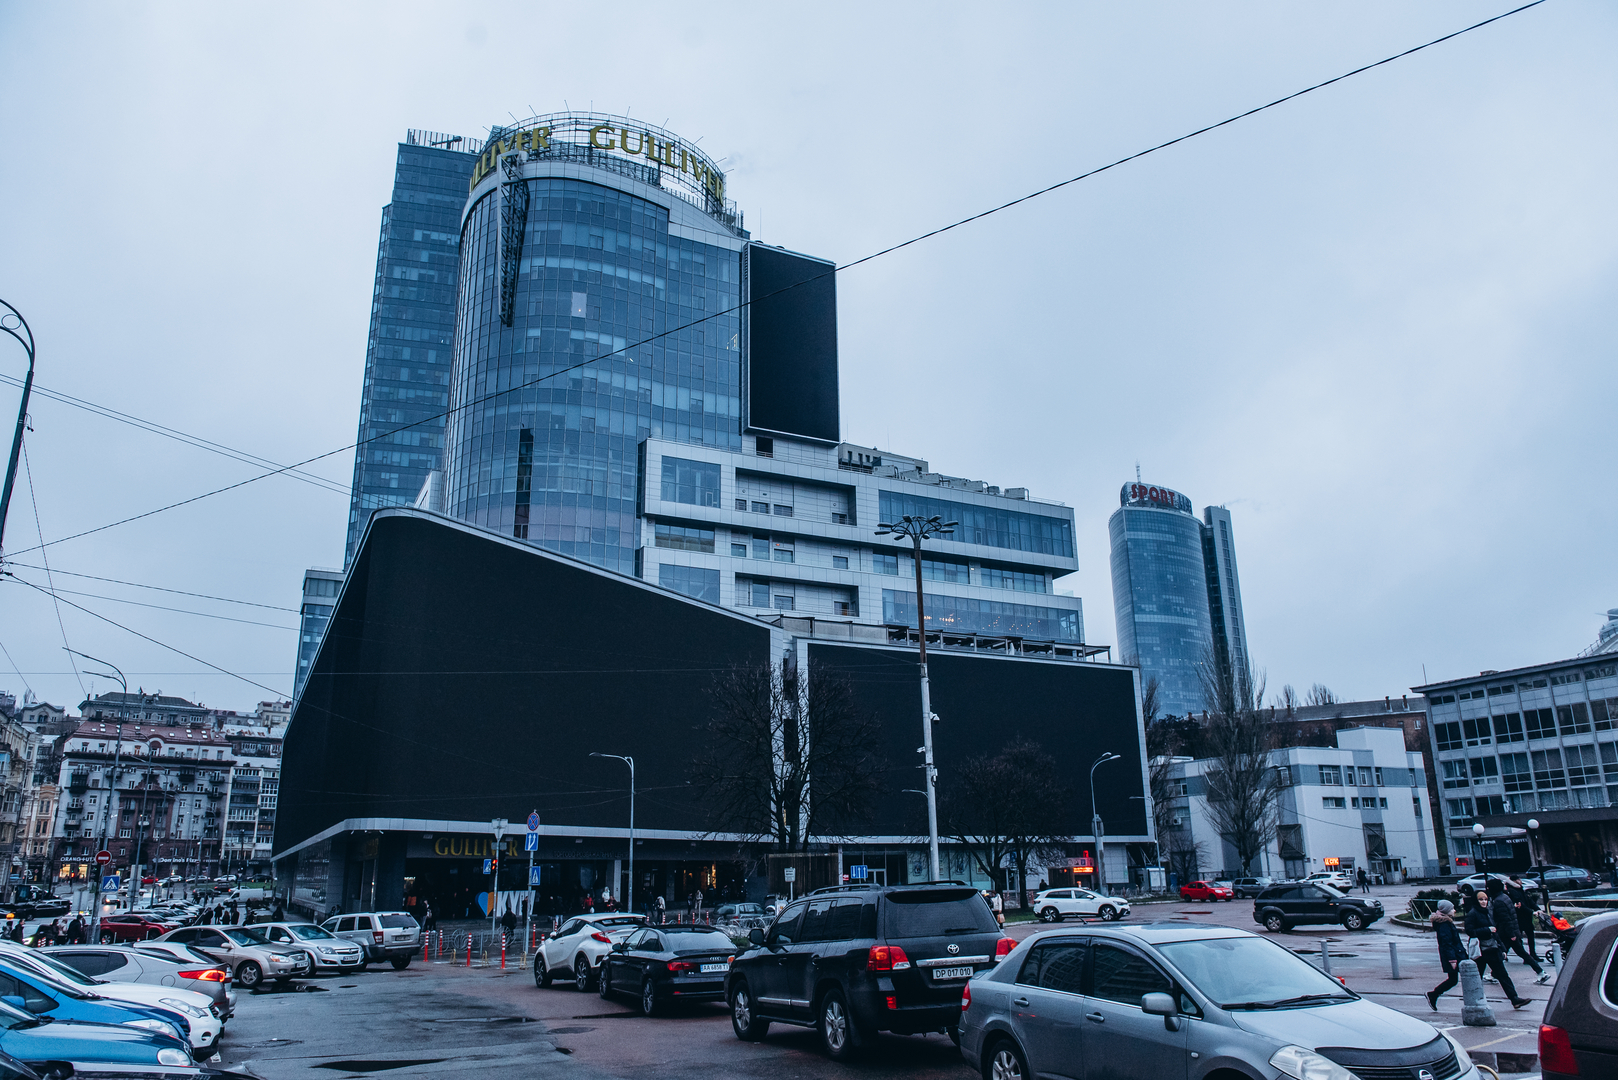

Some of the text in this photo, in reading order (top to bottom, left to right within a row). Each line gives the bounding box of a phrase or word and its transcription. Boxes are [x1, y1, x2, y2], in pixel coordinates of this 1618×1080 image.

[589, 125, 724, 207] GULLIVER
[1131, 484, 1175, 506] SPORT
[434, 837, 518, 857] GULLIVR
[935, 967, 971, 978] DP 017 010
